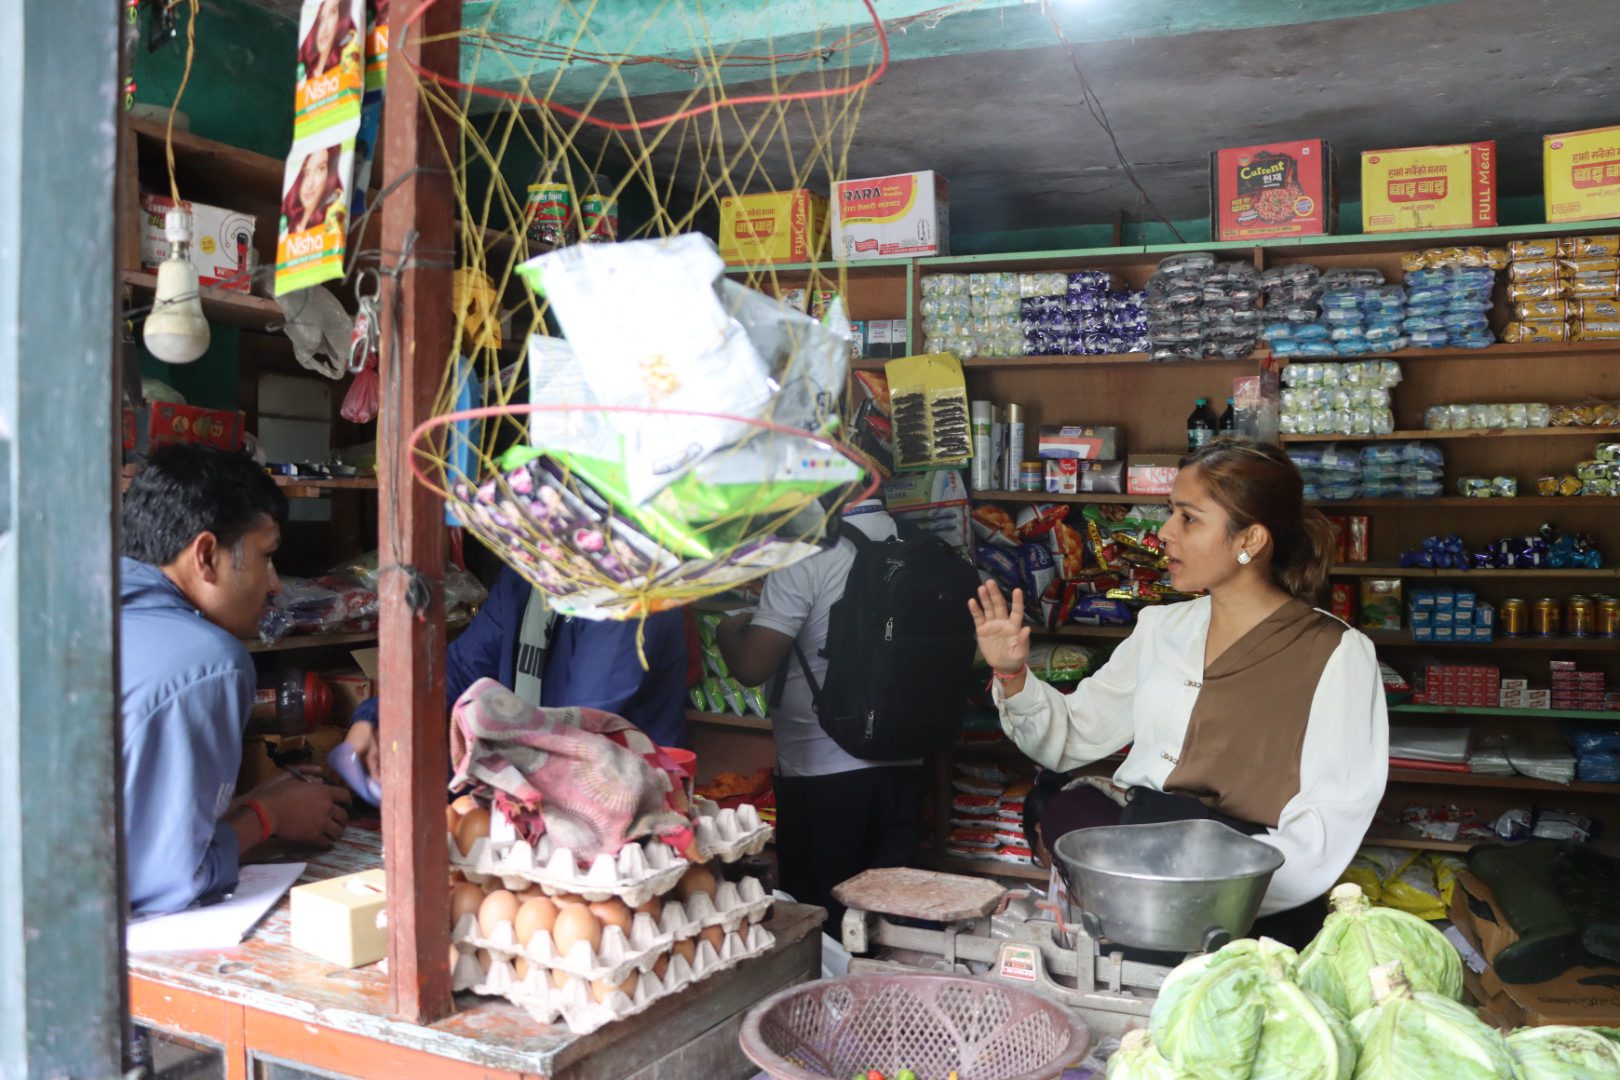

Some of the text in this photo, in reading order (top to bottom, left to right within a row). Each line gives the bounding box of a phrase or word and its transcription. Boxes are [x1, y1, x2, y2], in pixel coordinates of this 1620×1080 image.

[305, 75, 339, 104] Nisha
[1241, 161, 1285, 180] Current
[1478, 147, 1491, 220] FULL Meal
[844, 187, 882, 200] RARA
[286, 232, 324, 259] Nisha
